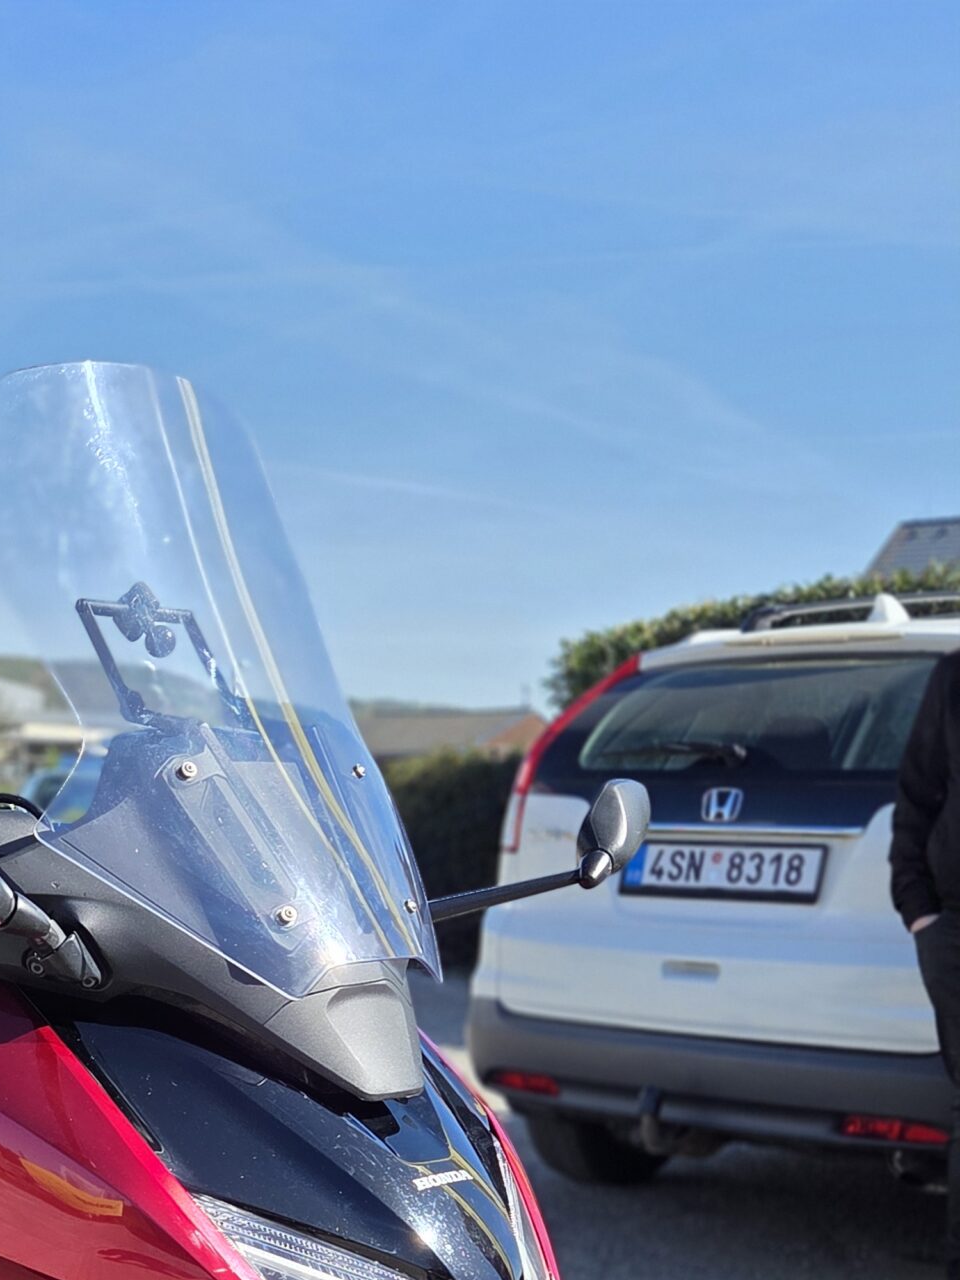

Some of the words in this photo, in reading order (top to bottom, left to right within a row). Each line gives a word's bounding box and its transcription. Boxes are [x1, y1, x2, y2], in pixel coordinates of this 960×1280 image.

[650, 849, 705, 884] 4SN
[726, 852, 805, 887] 8318
[412, 1169, 474, 1191] HONDA
